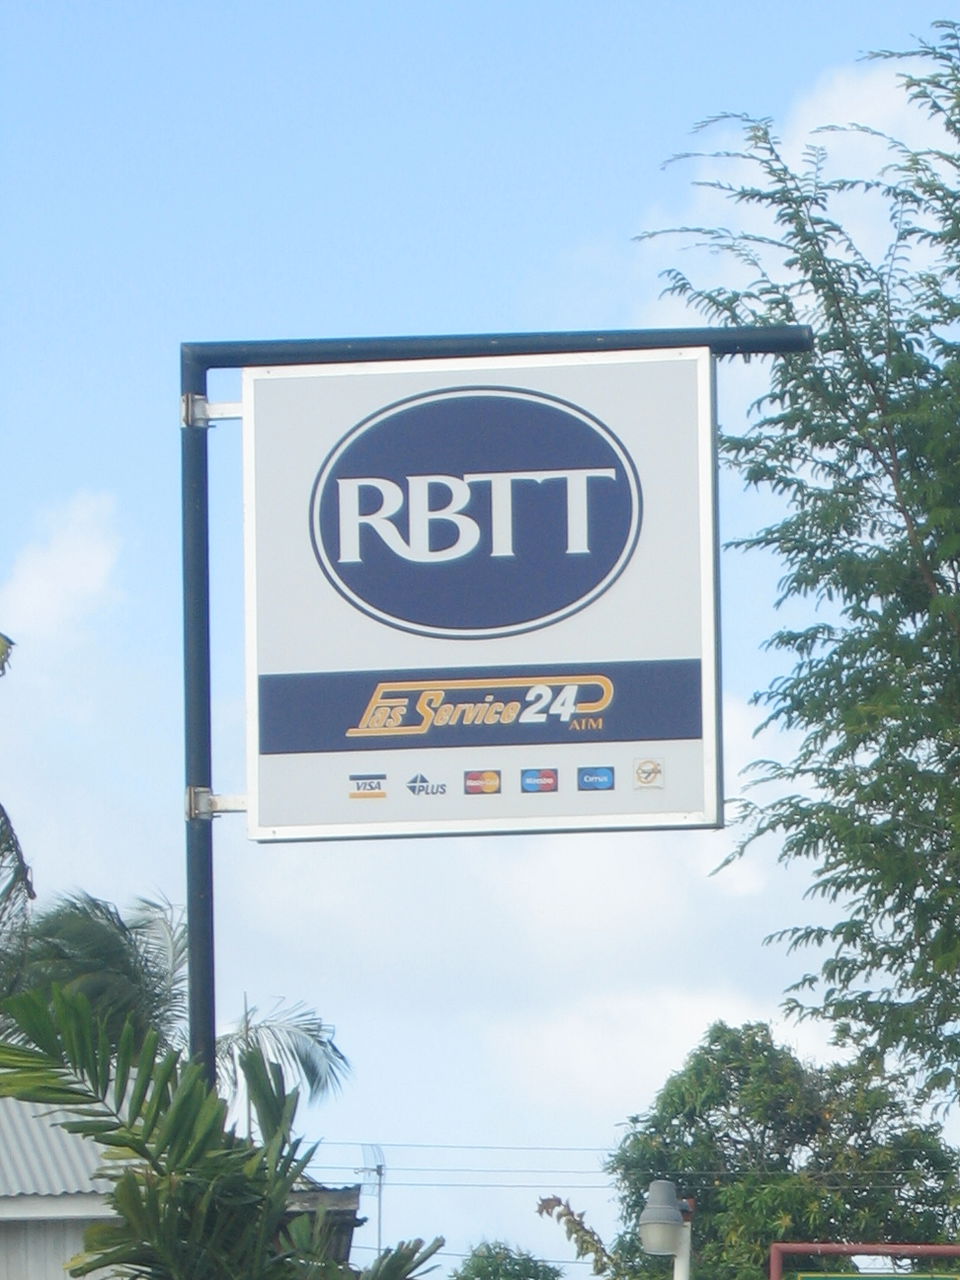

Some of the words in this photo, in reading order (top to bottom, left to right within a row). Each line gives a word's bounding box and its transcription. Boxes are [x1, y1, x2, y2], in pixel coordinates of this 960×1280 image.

[336, 468, 616, 563] RBTT
[568, 717, 604, 731] ATM
[356, 781, 382, 791] VISA
[417, 784, 447, 795] PLUS
